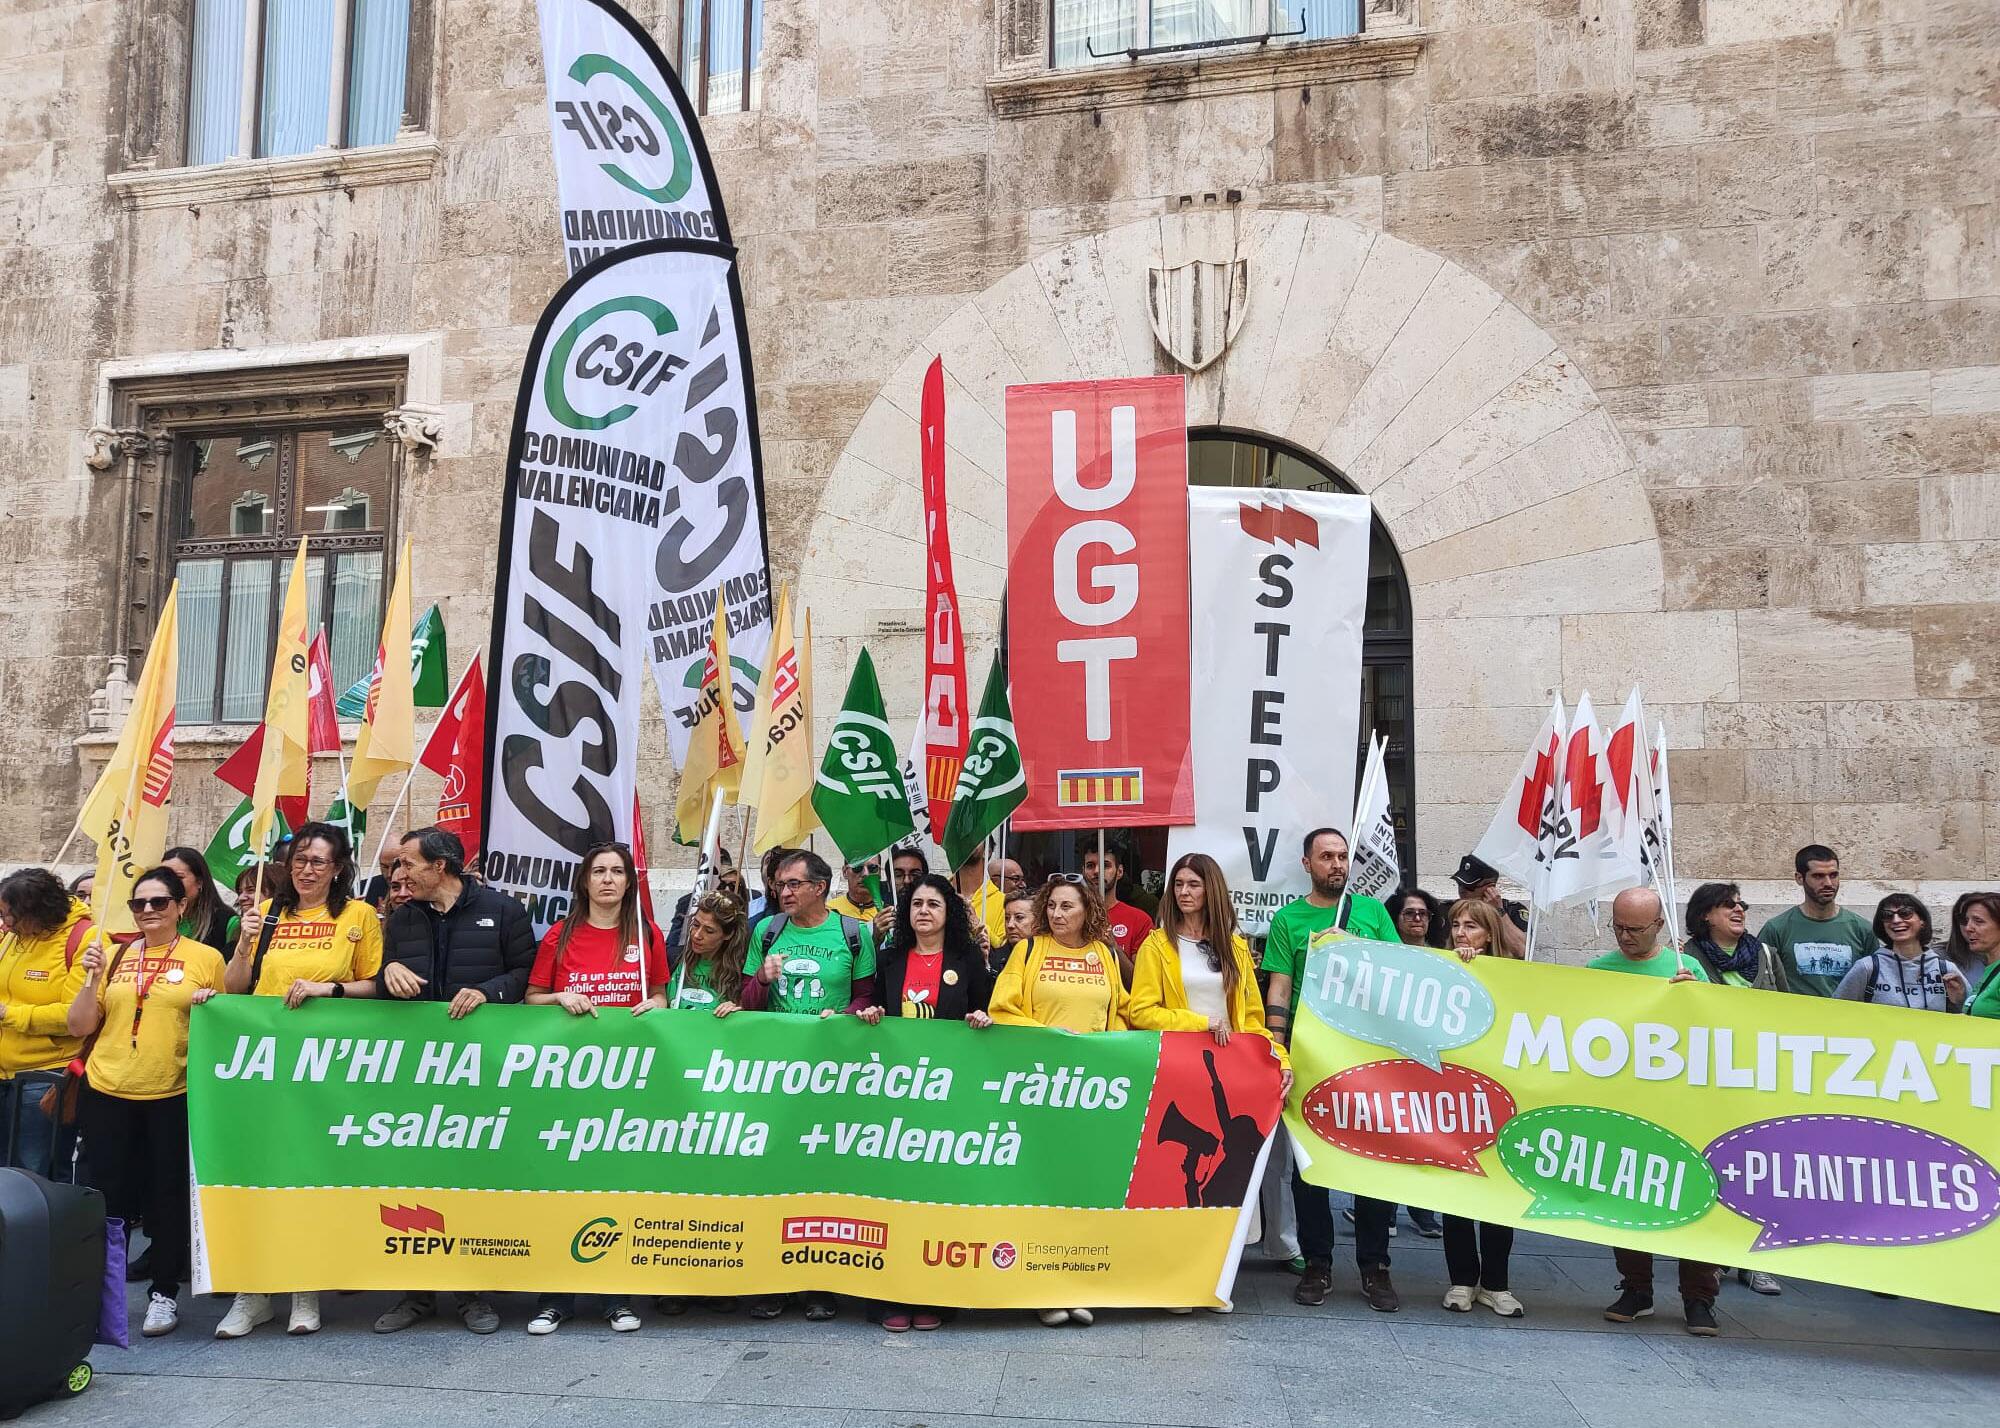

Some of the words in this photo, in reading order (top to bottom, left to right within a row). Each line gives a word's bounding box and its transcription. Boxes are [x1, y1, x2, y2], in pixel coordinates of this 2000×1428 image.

[575, 334, 690, 397] CSIF
[521, 431, 666, 492] COMUNIDAD
[519, 467, 661, 529] VALENCIANA
[1052, 405, 1139, 742] UGT
[501, 506, 622, 858] CSIF
[1240, 553, 1295, 883] STEPV
[831, 730, 903, 800] CSIF
[269, 938, 333, 950] ducació
[591, 973, 604, 981] un
[608, 971, 639, 980] servei
[1040, 972, 1106, 986] educació
[1876, 984, 1891, 992] NO
[591, 992, 631, 1005] qualitat
[214, 1035, 276, 1081] JA
[292, 1038, 404, 1084] N'HI
[413, 1041, 482, 1087] HA
[497, 1044, 656, 1090] PROU!
[683, 1049, 953, 1101] -burocràcia
[982, 1063, 1132, 1111] -ràtios
[1313, 1083, 1495, 1134] +VALENCIÀ
[328, 1104, 510, 1150] +salari
[538, 1108, 769, 1161] +plantilla
[798, 1117, 1022, 1166] +valencià
[1514, 1128, 1686, 1212] +SALARI
[1721, 1150, 1980, 1213] +PLANTILLES
[634, 1217, 684, 1231] Central
[688, 1219, 744, 1233] Sindical
[787, 1221, 856, 1240] CCOO
[384, 1237, 455, 1255] STEPV
[460, 1238, 531, 1247] INTERSINDICAL
[581, 1231, 623, 1248] CSIF
[632, 1236, 731, 1251] Independiente
[736, 1241, 743, 1253] y
[471, 1248, 530, 1256] VALENCIANA
[782, 1246, 884, 1270] educació
[922, 1239, 987, 1268] UGT
[1027, 1242, 1109, 1257] Ensenyament
[631, 1254, 648, 1265] de
[653, 1254, 744, 1268] Funcionarios
[1026, 1262, 1060, 1271] Serveis
[1062, 1261, 1096, 1271] Públics
[1097, 1262, 1111, 1271] PV
